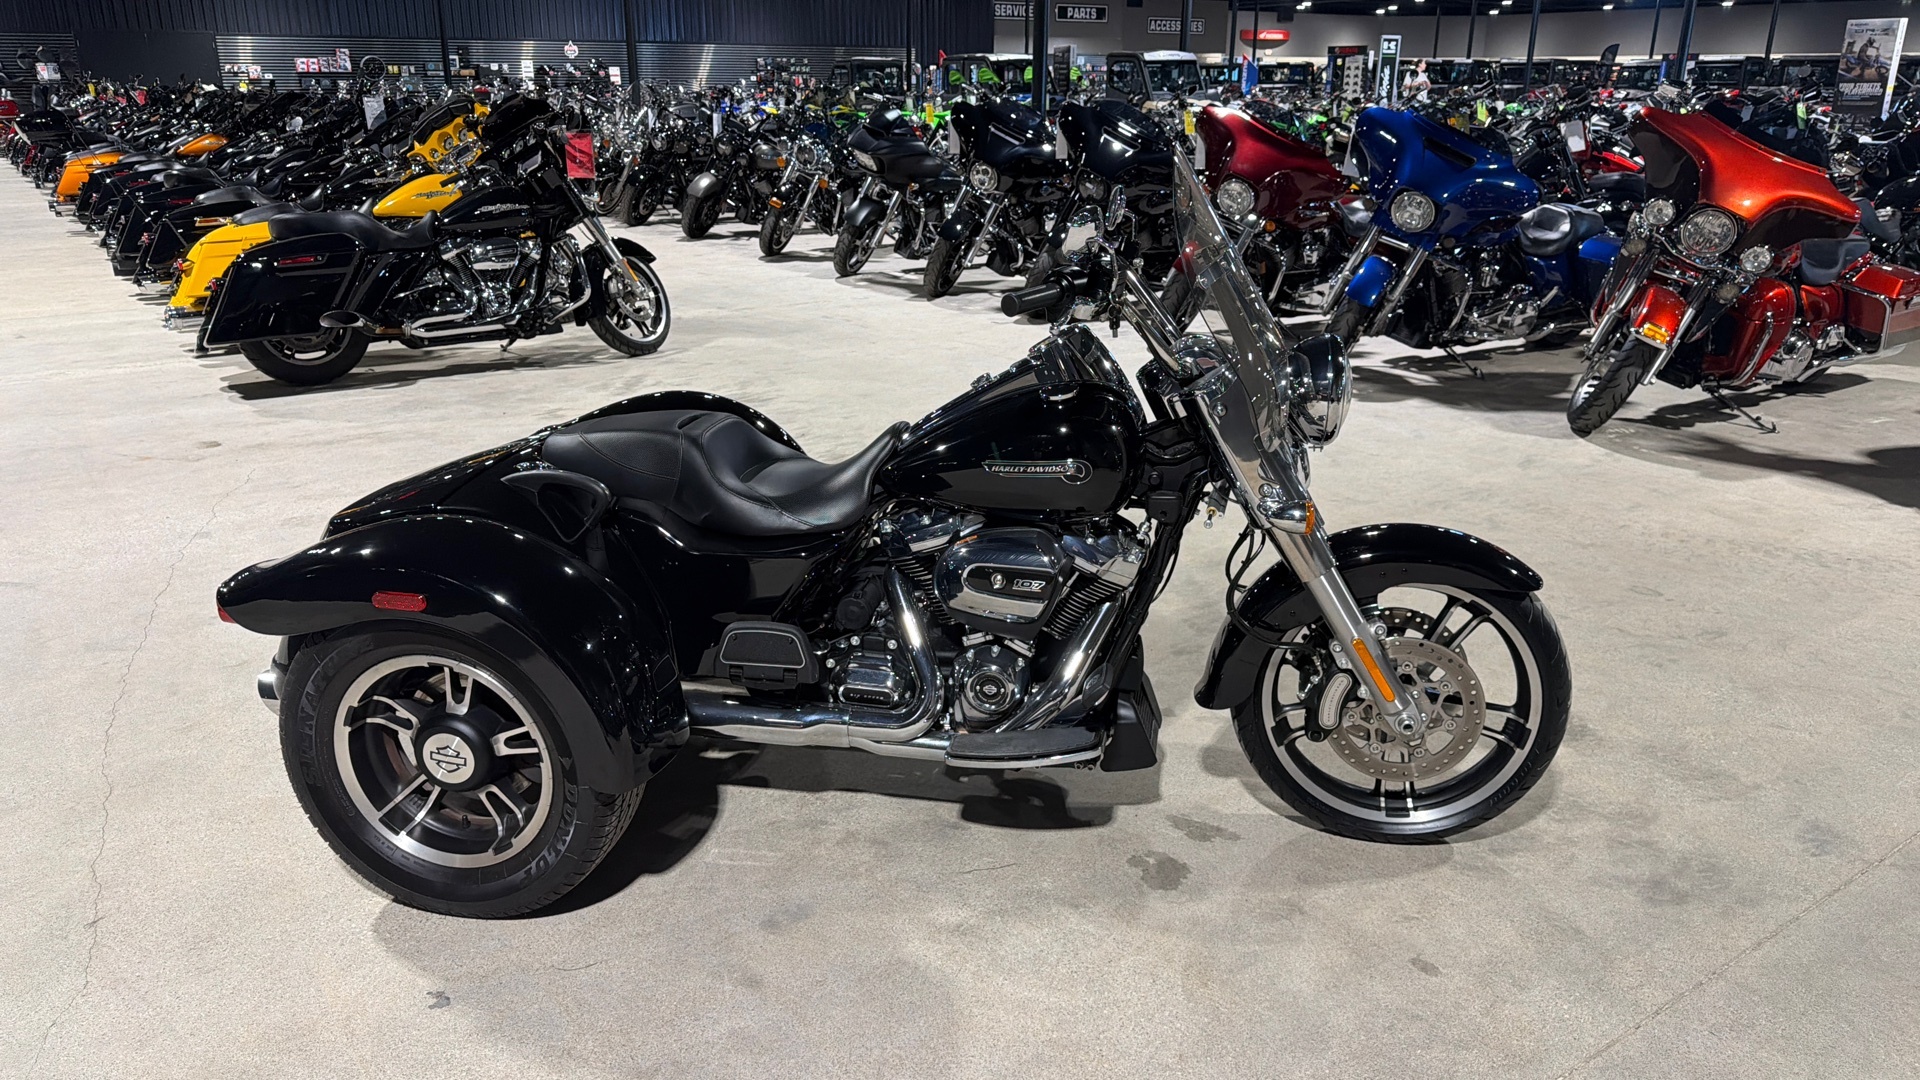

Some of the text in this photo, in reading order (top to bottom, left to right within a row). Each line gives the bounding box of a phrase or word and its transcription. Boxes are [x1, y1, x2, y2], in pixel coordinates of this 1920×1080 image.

[1067, 7, 1097, 19] PARTS
[1150, 20, 1203, 31] ACCESSIES
[991, 465, 1076, 473] HARLEY-DAVIDSO
[1012, 579, 1046, 591] 107
